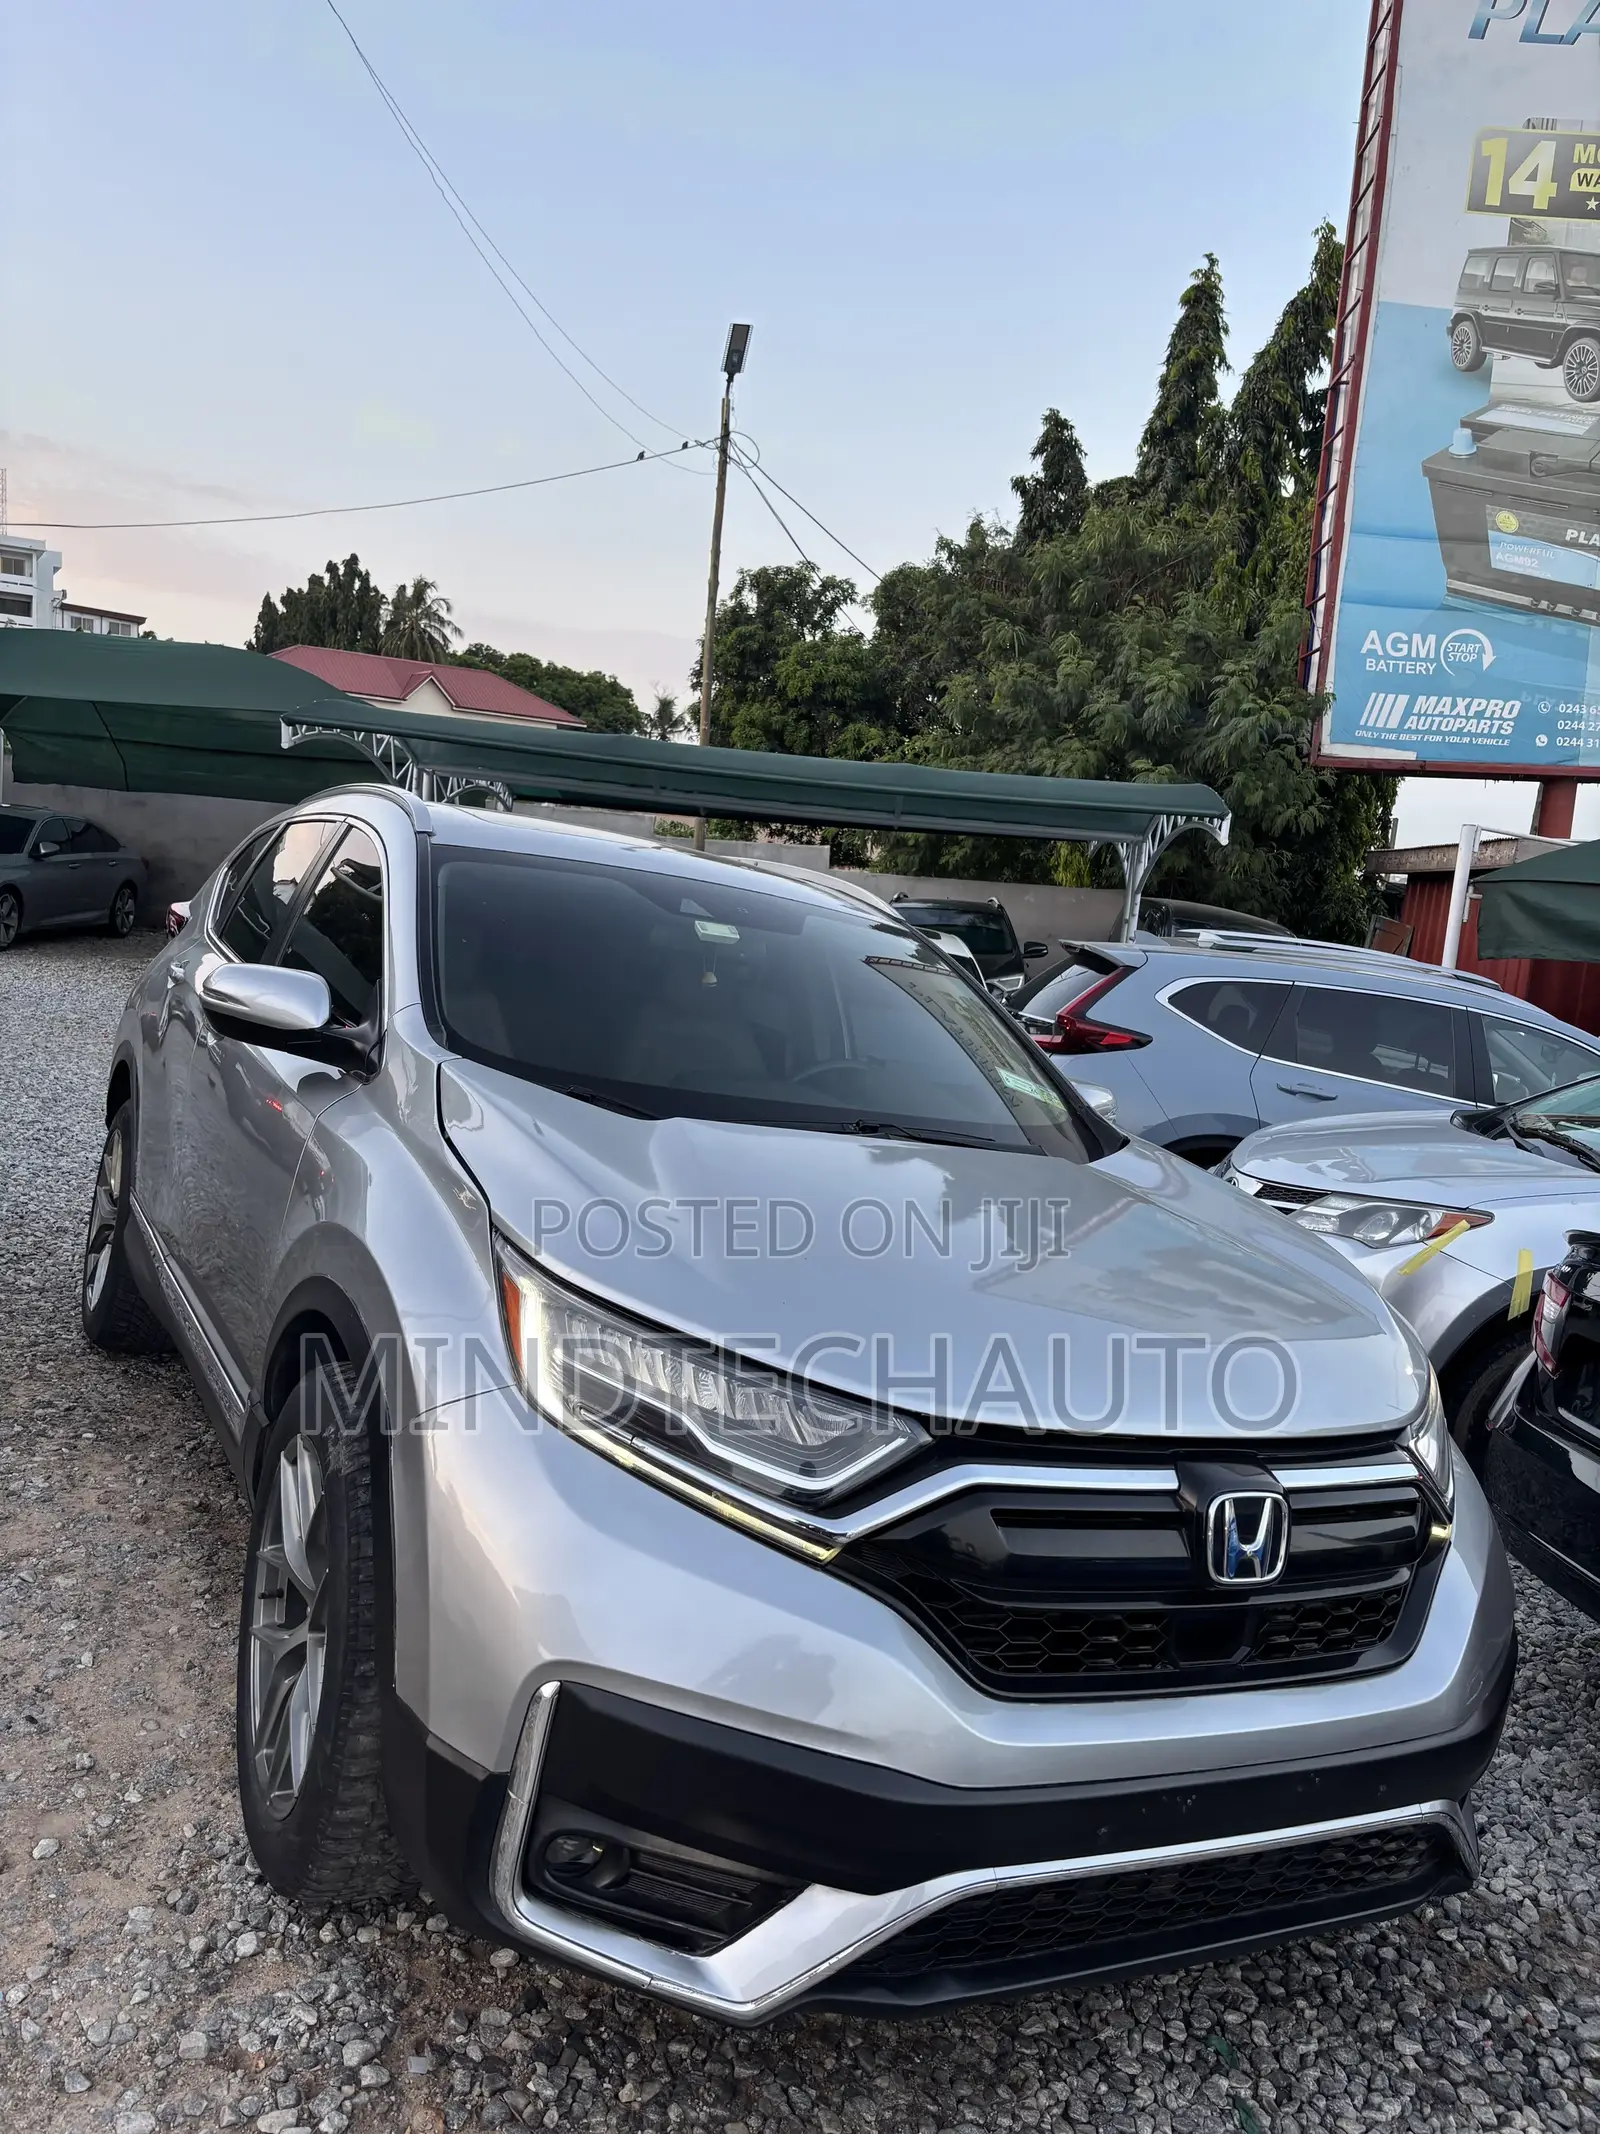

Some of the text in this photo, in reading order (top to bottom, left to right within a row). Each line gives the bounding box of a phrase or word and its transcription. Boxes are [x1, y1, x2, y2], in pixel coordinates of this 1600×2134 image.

[1573, 143, 1600, 164] M
[1481, 138, 1557, 210] 14
[1565, 529, 1600, 546] PLA
[1360, 630, 1437, 659] AGM
[1446, 642, 1482, 653] START
[1447, 652, 1478, 663] STOP
[1365, 658, 1437, 675] BATTERY
[1412, 695, 1522, 719] MAXPRO
[1558, 703, 1587, 714] 0243
[1403, 715, 1515, 735] AUTOPARTS
[1557, 720, 1586, 730] 0244
[1355, 729, 1511, 746] ONLY THE BEST FOR YOUR VEHICLE
[1556, 736, 1584, 747] 0244
